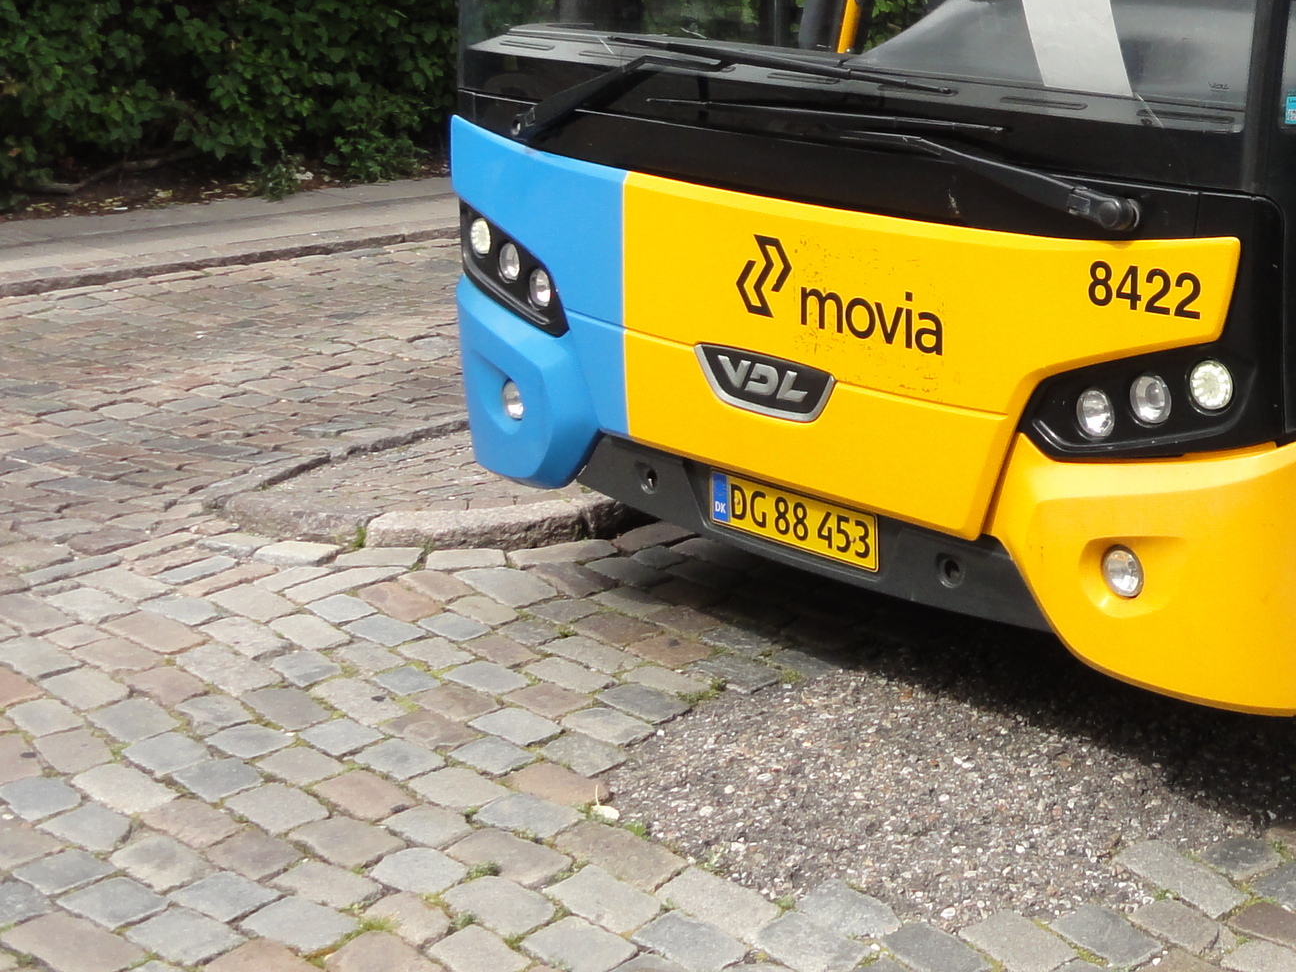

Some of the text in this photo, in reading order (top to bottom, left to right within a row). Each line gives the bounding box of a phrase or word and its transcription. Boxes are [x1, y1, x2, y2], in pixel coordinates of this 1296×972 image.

[1088, 260, 1202, 320] 8422
[800, 286, 944, 356] movia
[716, 355, 809, 403] VDL
[714, 500, 727, 514] DK
[730, 483, 871, 559] DG 88 453
